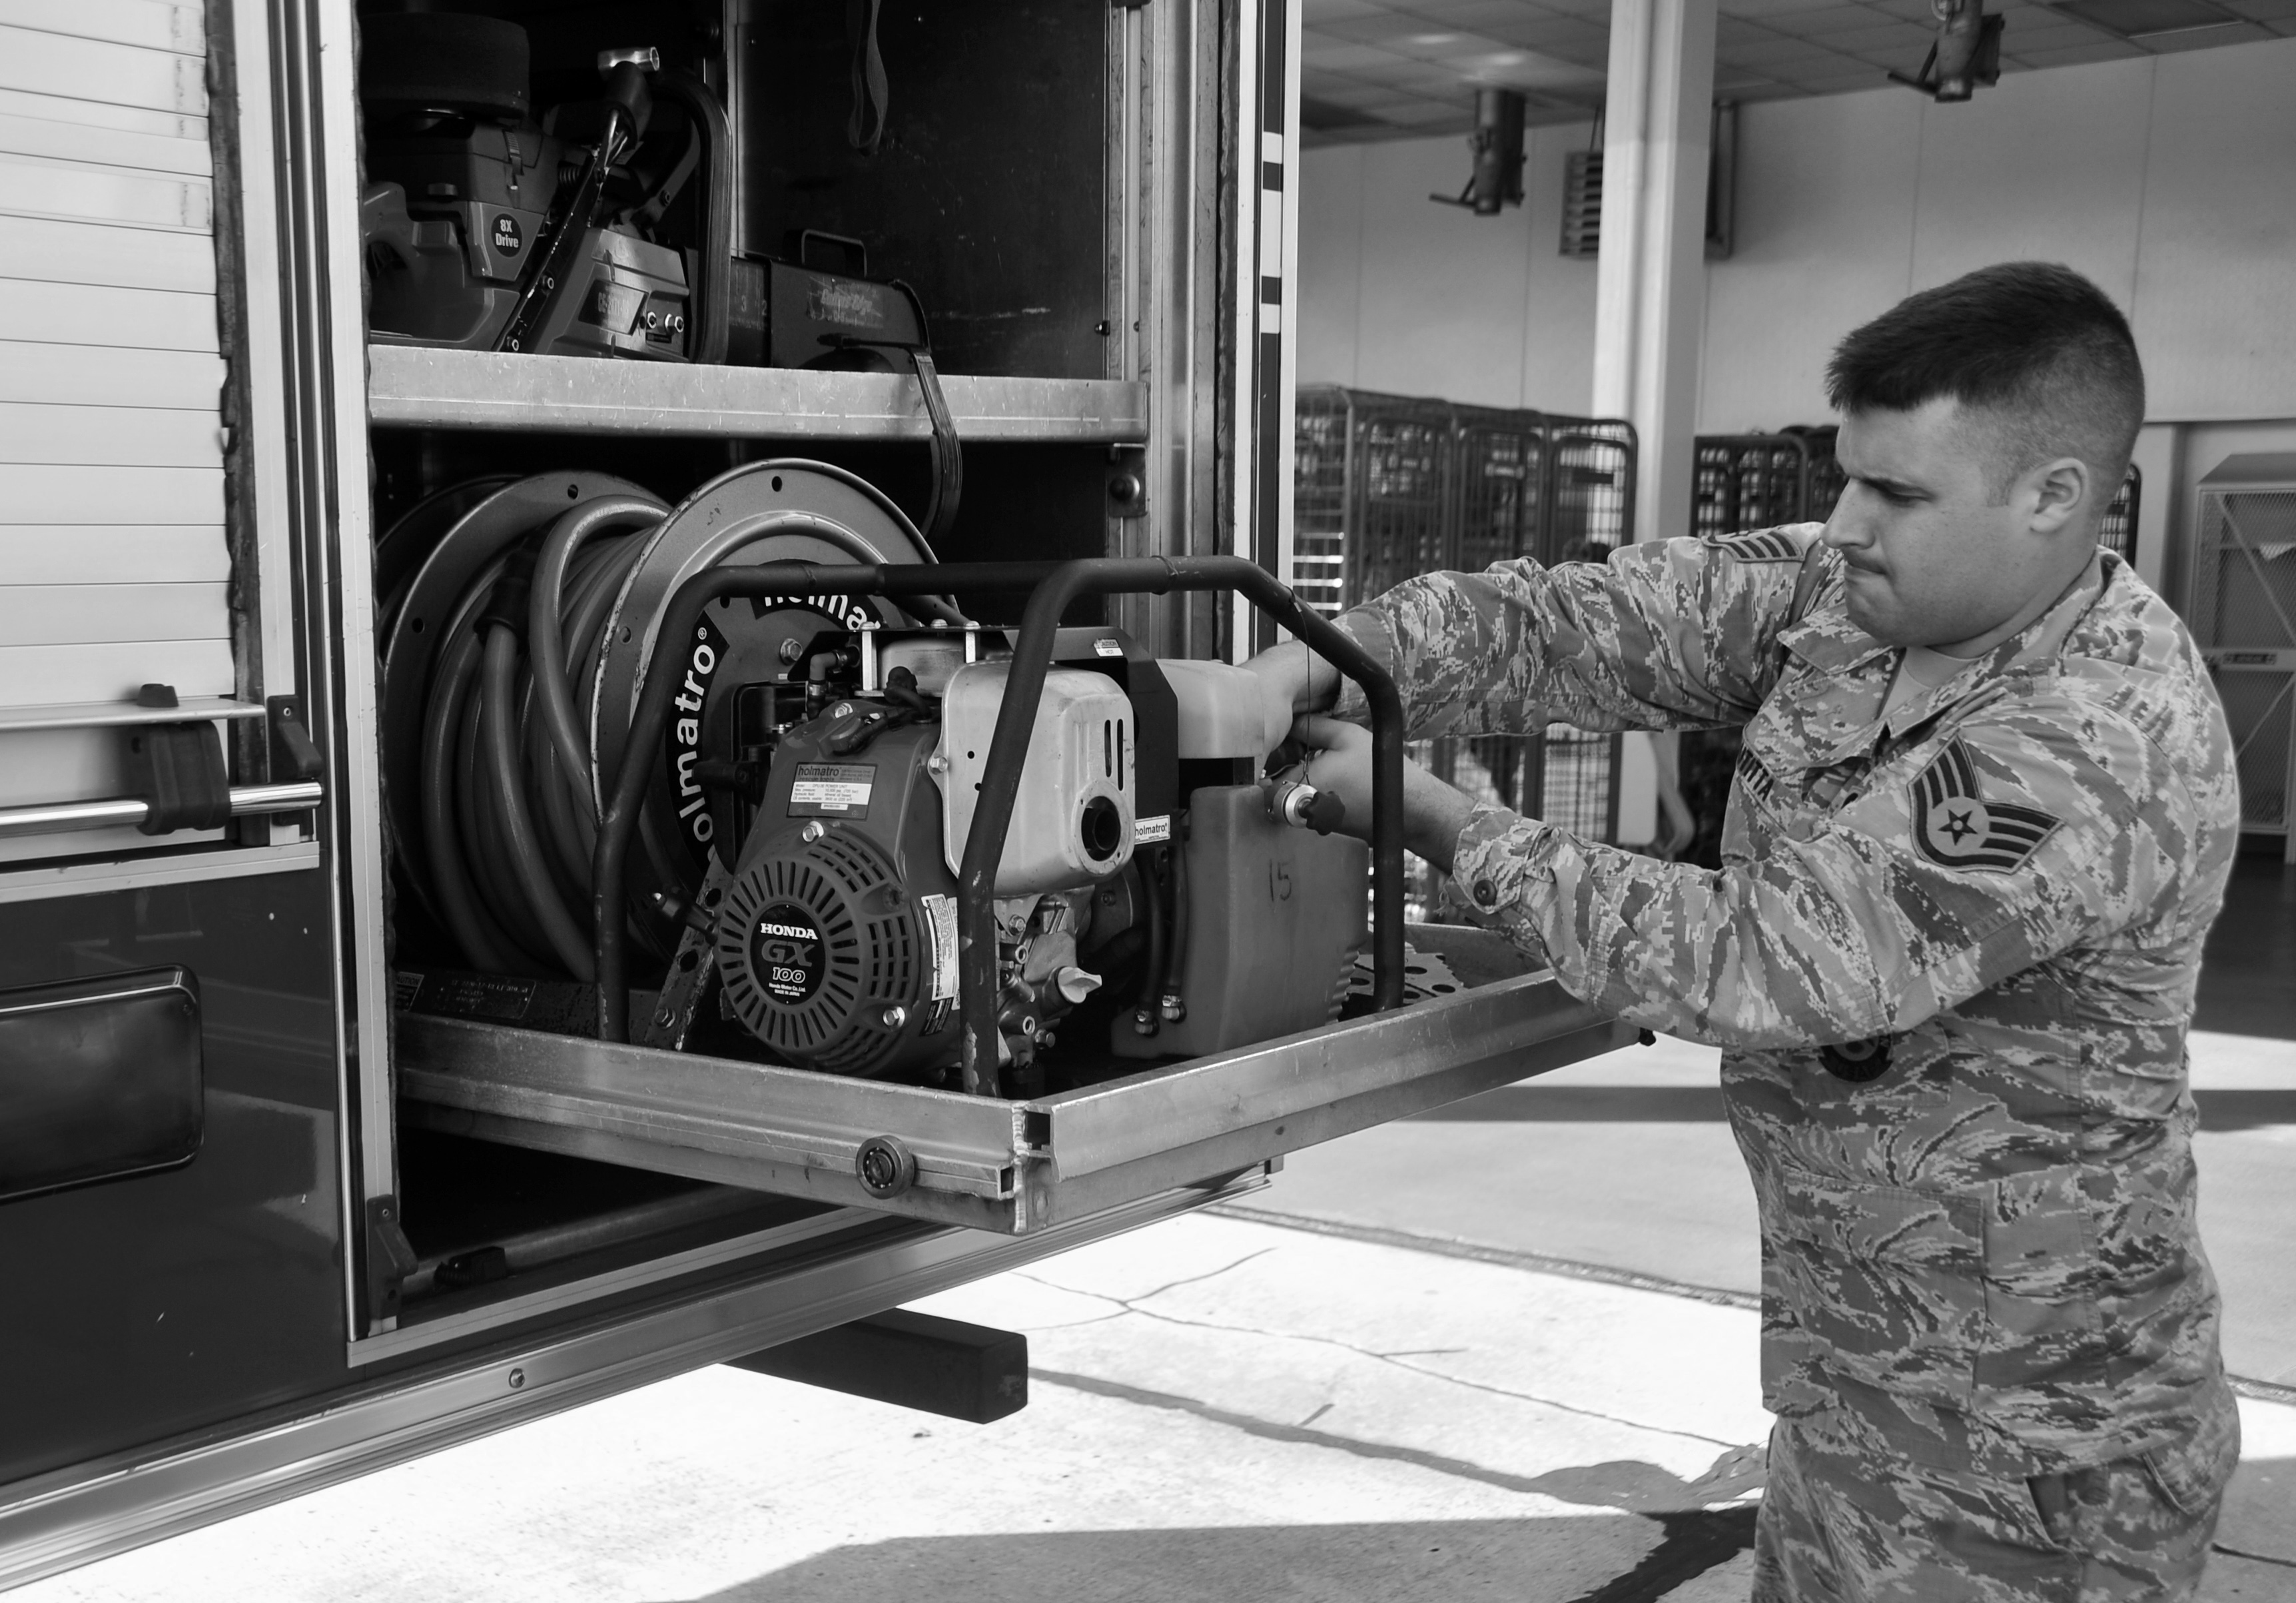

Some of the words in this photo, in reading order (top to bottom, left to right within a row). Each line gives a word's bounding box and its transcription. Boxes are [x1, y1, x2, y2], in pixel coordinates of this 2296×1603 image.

[500, 219, 513, 233] 8X
[495, 233, 519, 249] Drive
[798, 766, 840, 777] holmatro
[1269, 859, 1292, 902] 15
[760, 923, 819, 940] HONDA
[761, 939, 815, 967] GX
[397, 975, 419, 985] AUTION
[773, 967, 806, 983] 100
